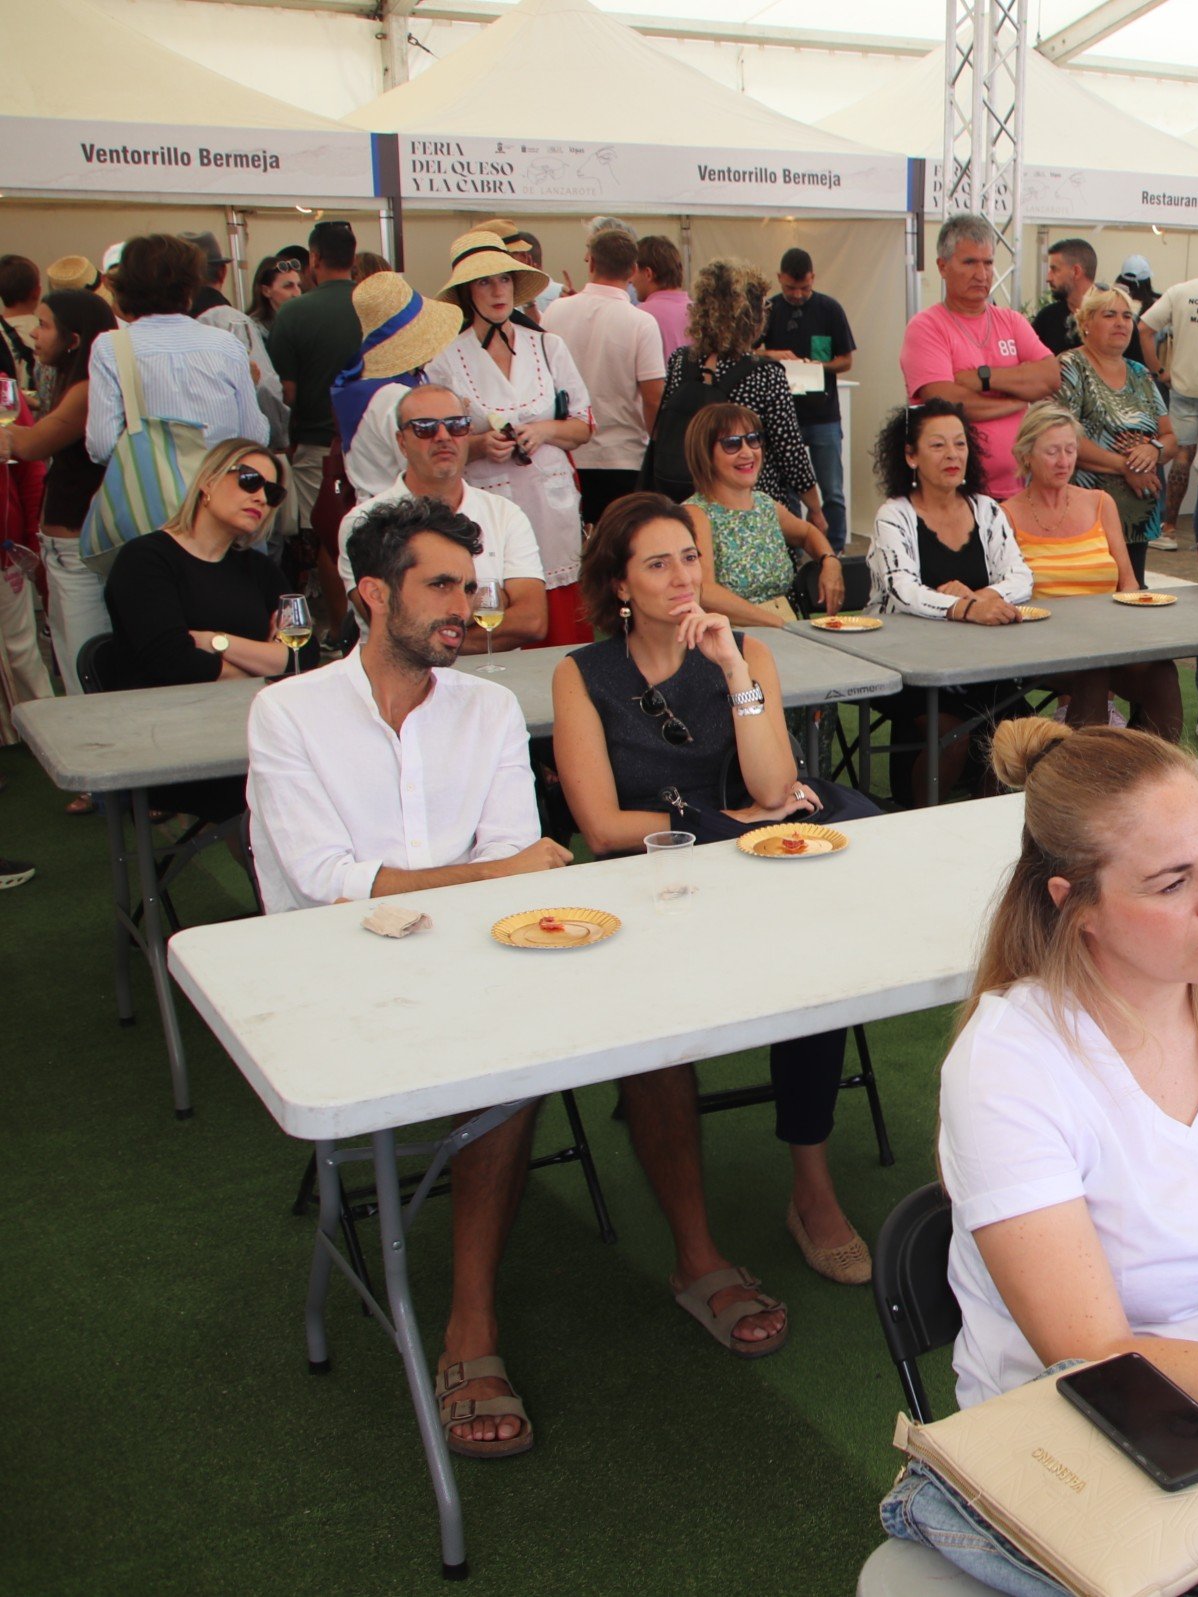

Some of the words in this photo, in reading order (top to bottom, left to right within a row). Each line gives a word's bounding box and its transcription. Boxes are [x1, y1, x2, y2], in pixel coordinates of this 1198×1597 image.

[411, 141, 464, 156] FERIA
[81, 143, 191, 167] Ventorrillo
[199, 148, 281, 173] Bermeja
[411, 159, 447, 175] DEL
[451, 161, 514, 177] QUESO
[411, 178, 422, 192] Y
[429, 179, 451, 193] LA
[456, 179, 516, 194] CABRA
[698, 165, 778, 184] Ventorrillo
[783, 168, 841, 190] Bermeja
[540, 187, 597, 196] LANZAROTE
[998, 339, 1017, 356] 86
[1032, 1447, 1087, 1494] VALENTINO
